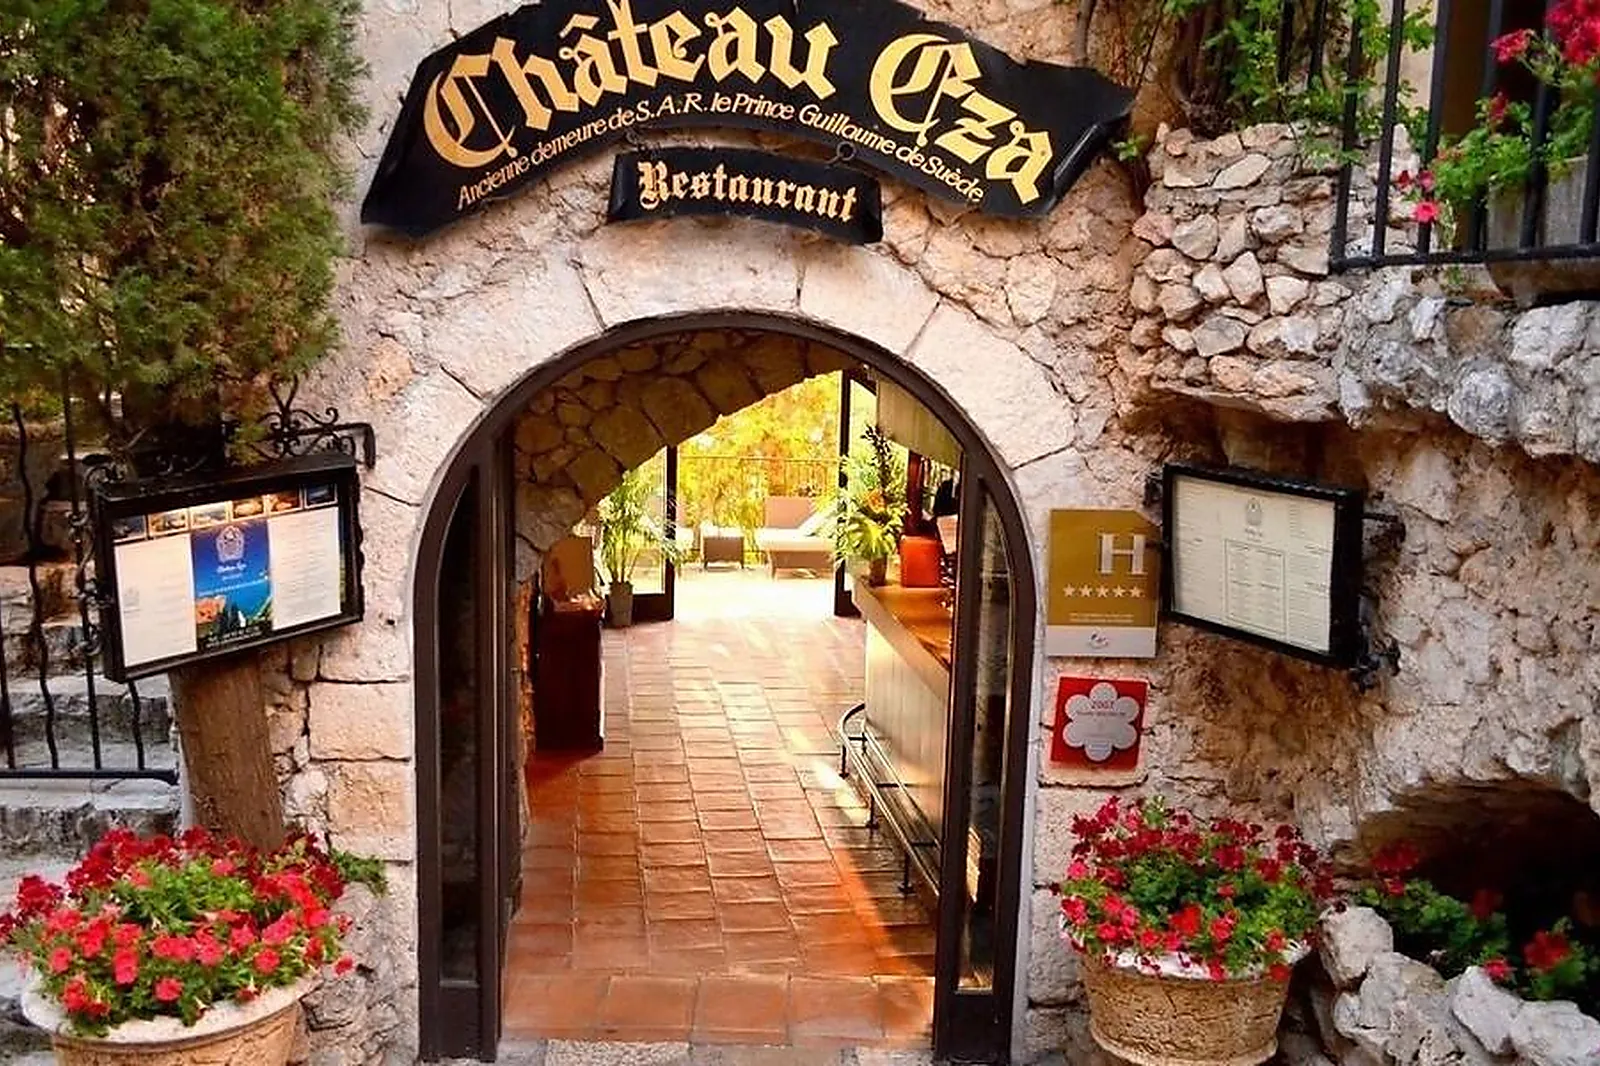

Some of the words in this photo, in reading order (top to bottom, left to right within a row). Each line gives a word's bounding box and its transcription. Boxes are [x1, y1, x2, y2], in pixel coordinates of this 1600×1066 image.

[423, 0, 838, 168] Château
[869, 34, 1053, 204] Eza
[457, 156, 530, 210] Ancienne
[530, 116, 607, 166] demeure
[608, 107, 635, 130] de
[710, 92, 731, 113] le
[731, 93, 795, 120] Prince
[799, 103, 897, 155] Guillaume
[896, 146, 925, 168] de
[920, 155, 985, 203] Suède
[637, 160, 857, 222] Restaurant
[1096, 532, 1148, 576] H
